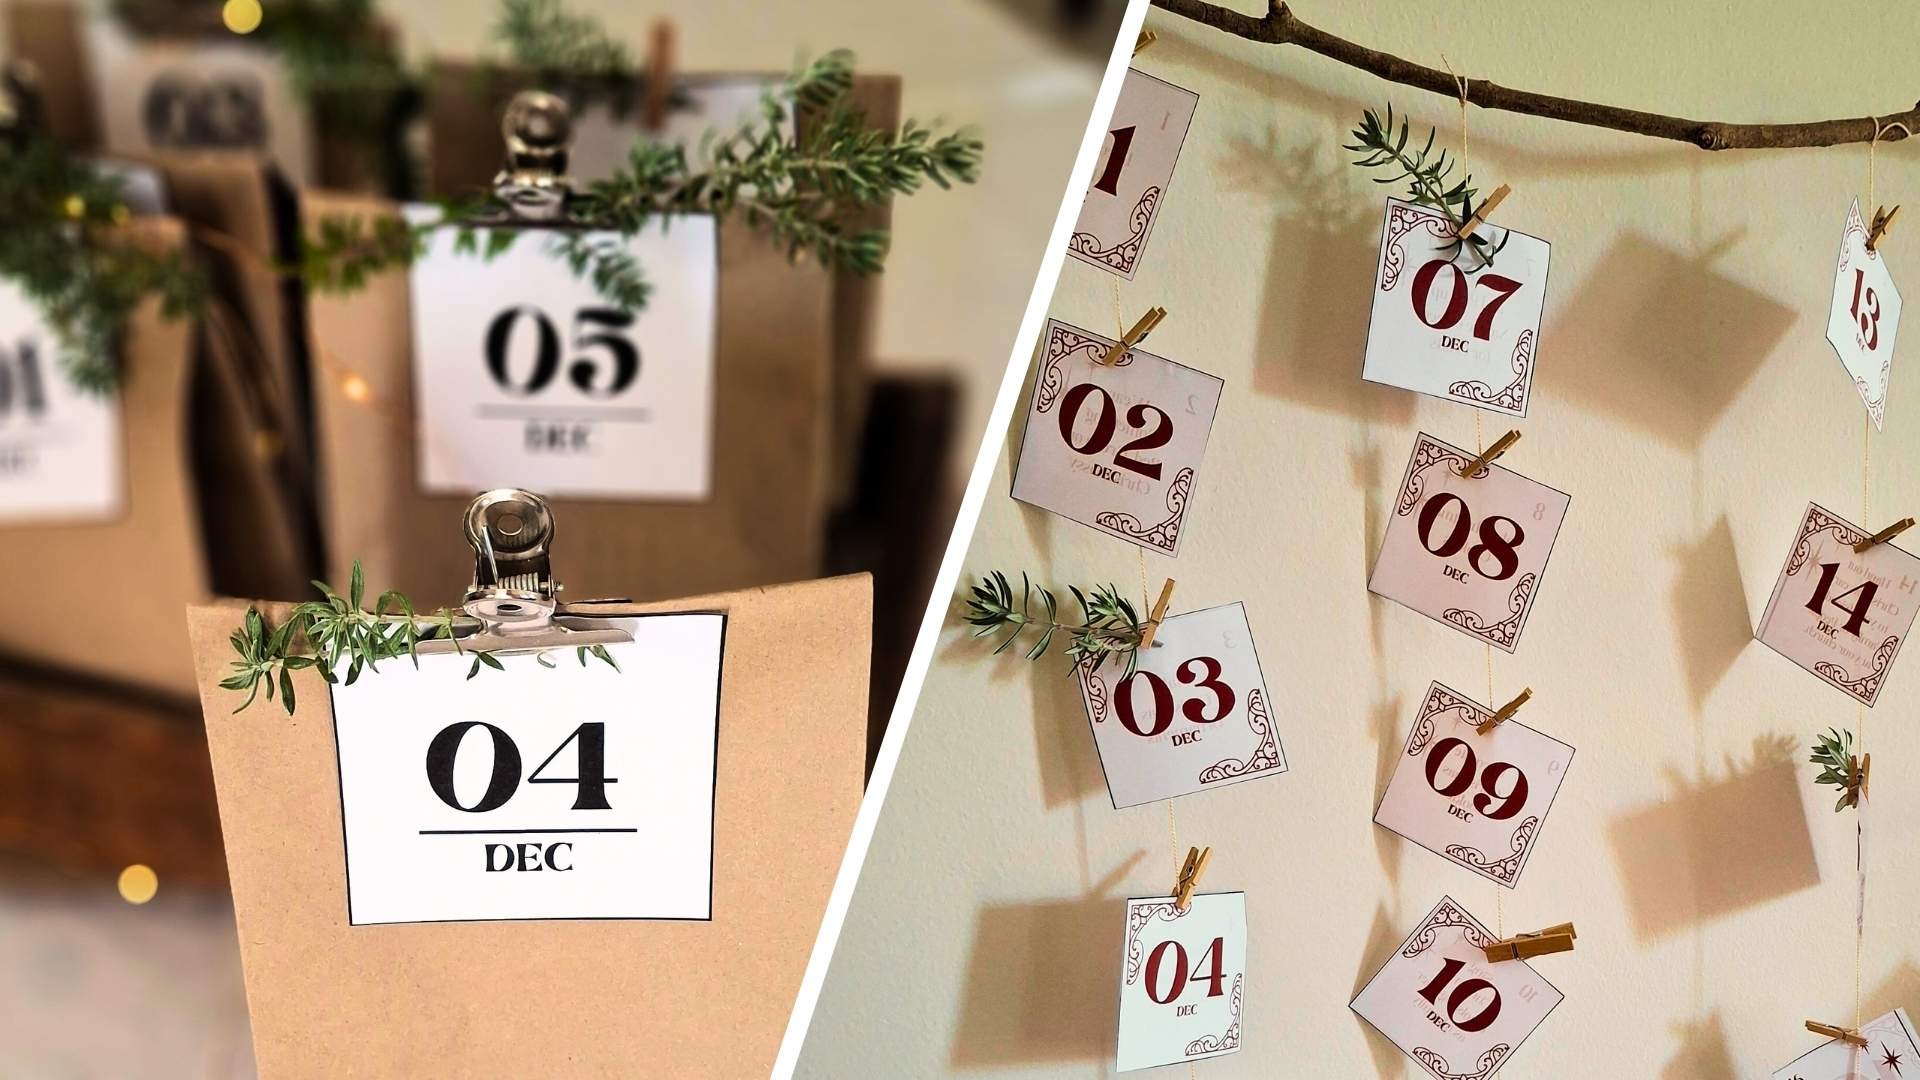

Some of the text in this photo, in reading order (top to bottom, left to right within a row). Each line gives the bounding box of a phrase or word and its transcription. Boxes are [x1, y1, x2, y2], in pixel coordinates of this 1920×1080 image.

[1411, 258, 1524, 342] 07
[1849, 267, 1881, 351] 13
[484, 304, 642, 398] 05
[1441, 335, 1470, 353] DEC
[1058, 382, 1174, 482] 02
[1091, 462, 1122, 485] DEC
[1417, 492, 1525, 581] 08
[1442, 564, 1470, 585] DEC
[1805, 562, 1879, 638] 14
[1816, 620, 1840, 640] DEC
[1113, 656, 1236, 737] 03
[426, 720, 618, 813] 04
[1172, 729, 1202, 747] DEC
[1425, 737, 1529, 821] 09
[1447, 803, 1474, 824] DEC
[485, 842, 574, 873] DEC
[1144, 936, 1228, 1005] 04
[1417, 957, 1502, 1033] 10
[1176, 1003, 1198, 1017] DEC
[1426, 1010, 1452, 1033] DEC
